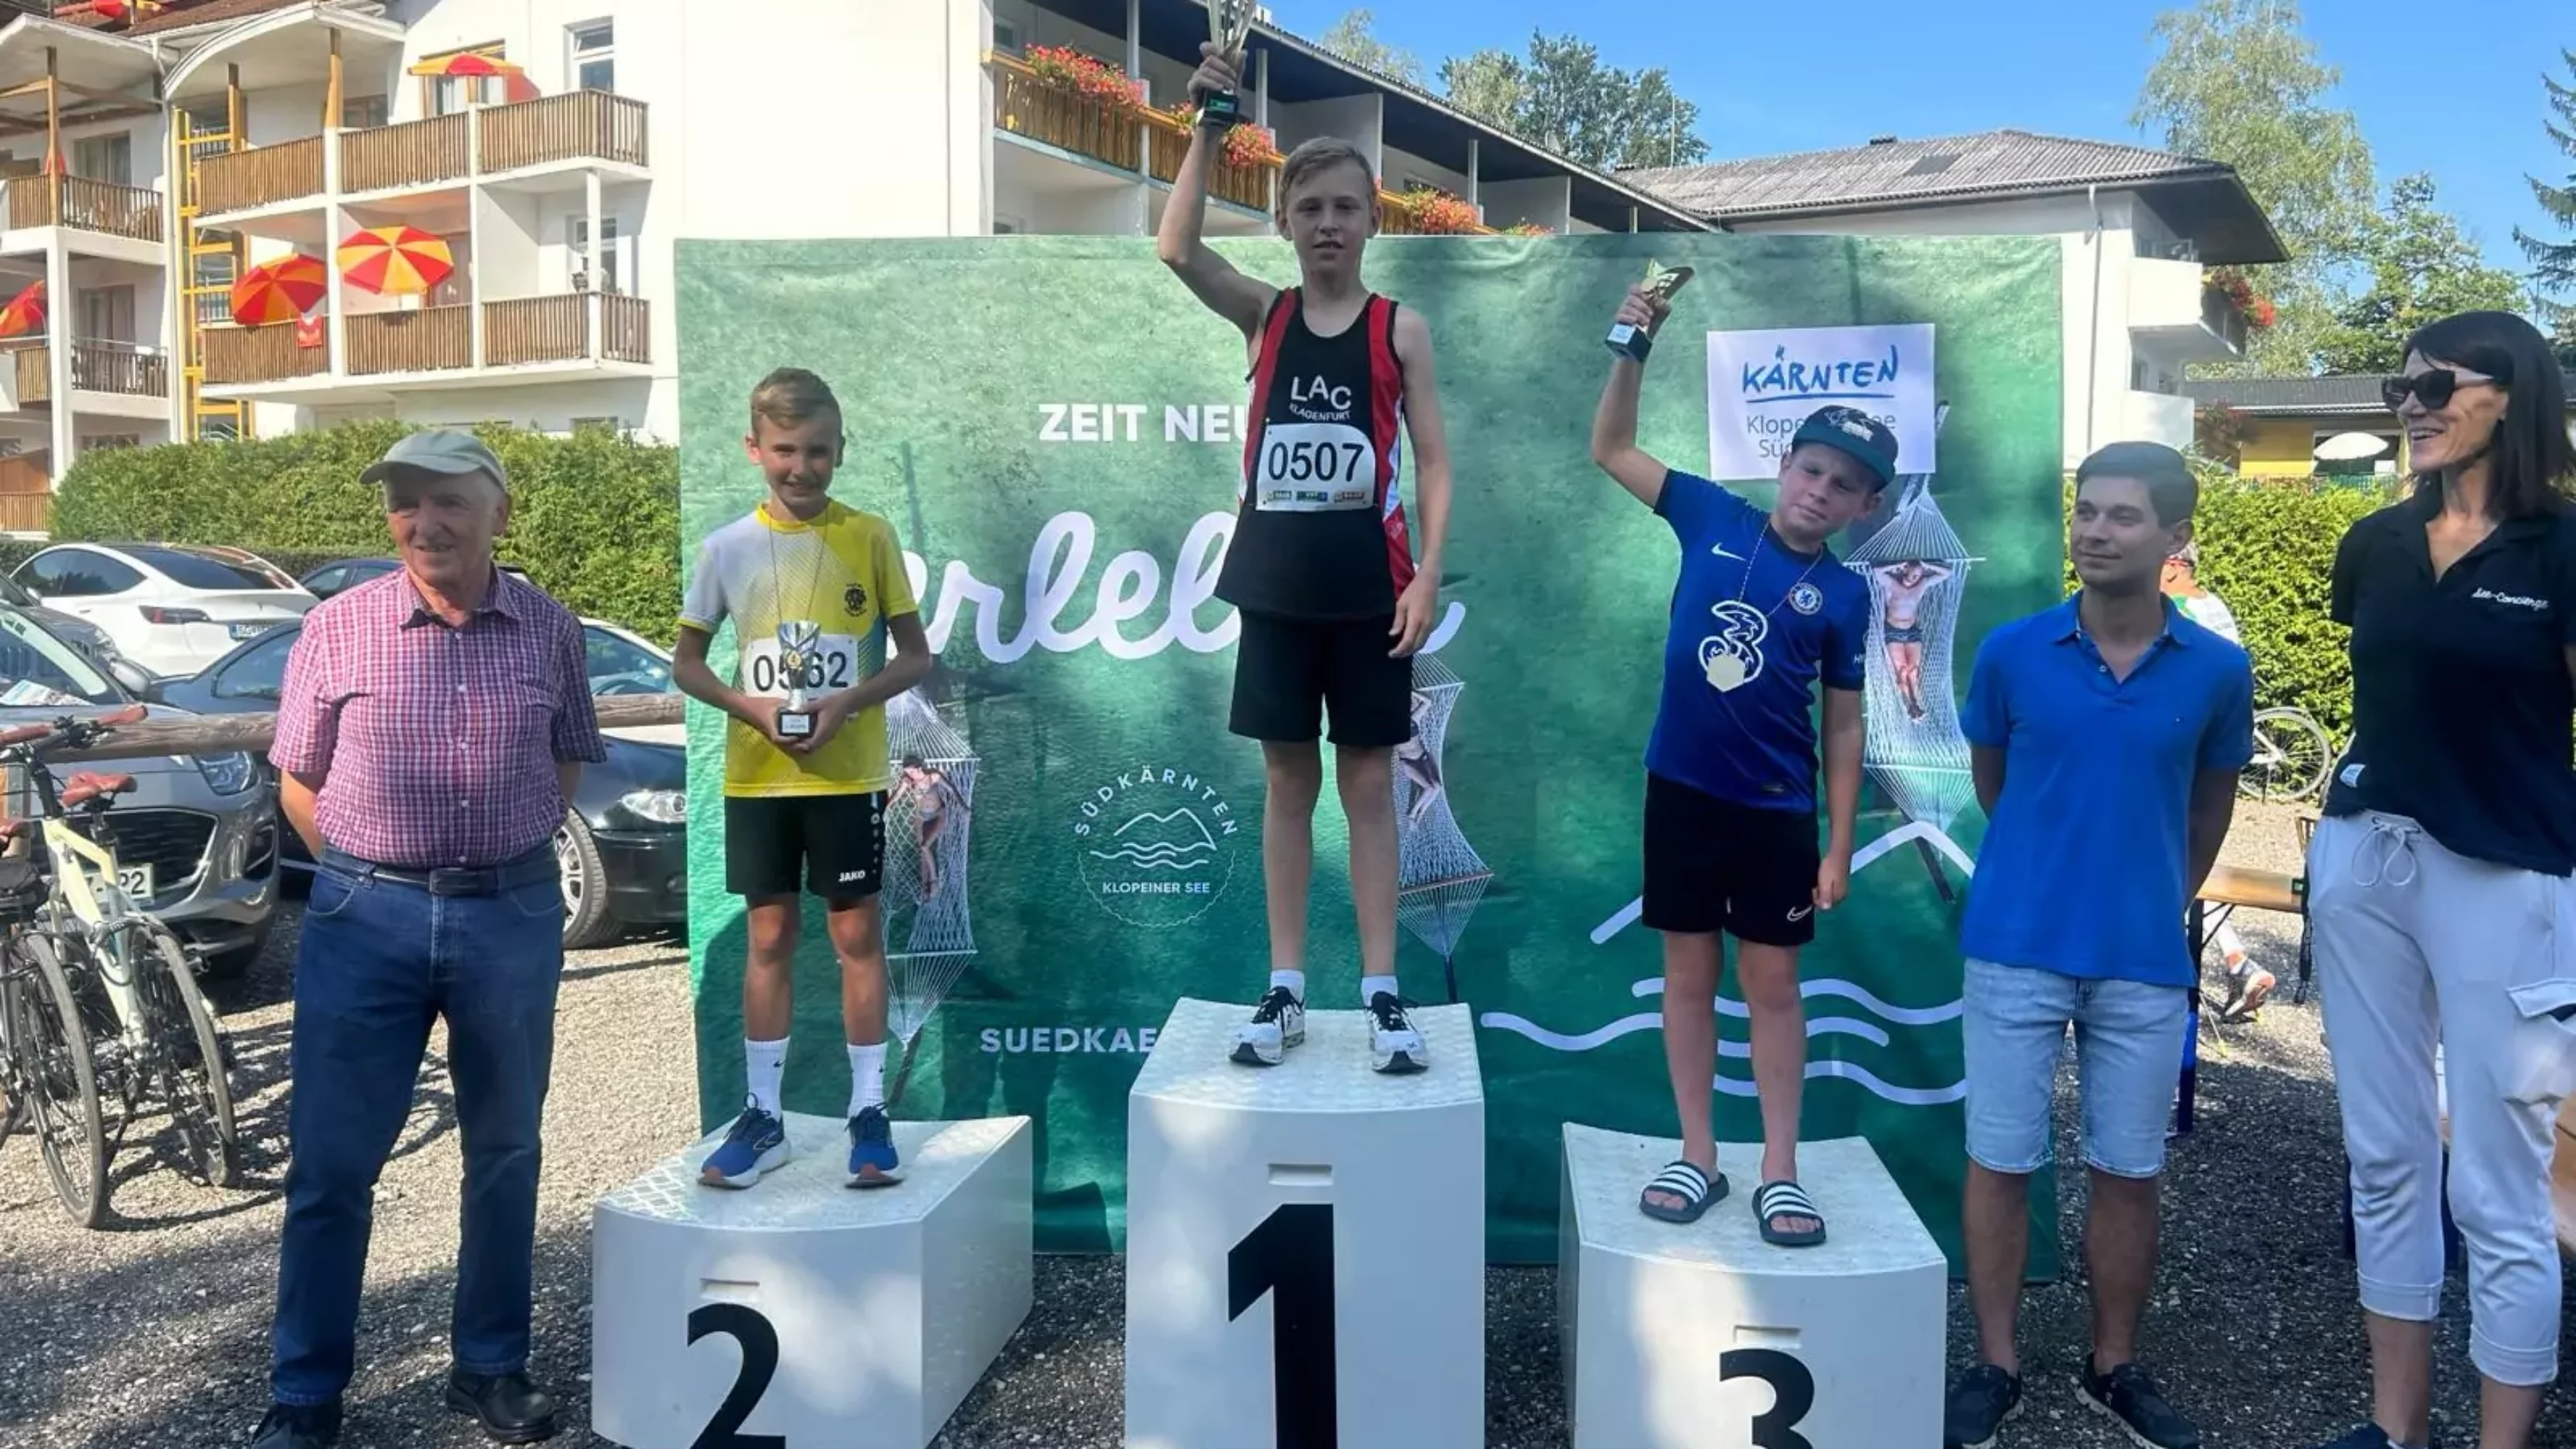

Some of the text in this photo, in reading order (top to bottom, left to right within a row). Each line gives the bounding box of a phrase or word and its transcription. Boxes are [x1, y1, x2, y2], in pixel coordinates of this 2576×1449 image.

[1743, 344, 1898, 393] KÄRNTEN
[1291, 374, 1351, 410] LAC
[1038, 402, 1148, 443] ZEIT
[1268, 441, 1365, 483] 0507
[1075, 764, 1238, 837] SÜDKÄRNTEN
[838, 869, 866, 883] JAKO
[1102, 881, 1211, 894] KLOPEINER SEE
[980, 1027, 1157, 1053] SUEDKAE
[1227, 1203, 1338, 1449] 1
[687, 1303, 786, 1449] 2
[1720, 1348, 1814, 1449] 3
